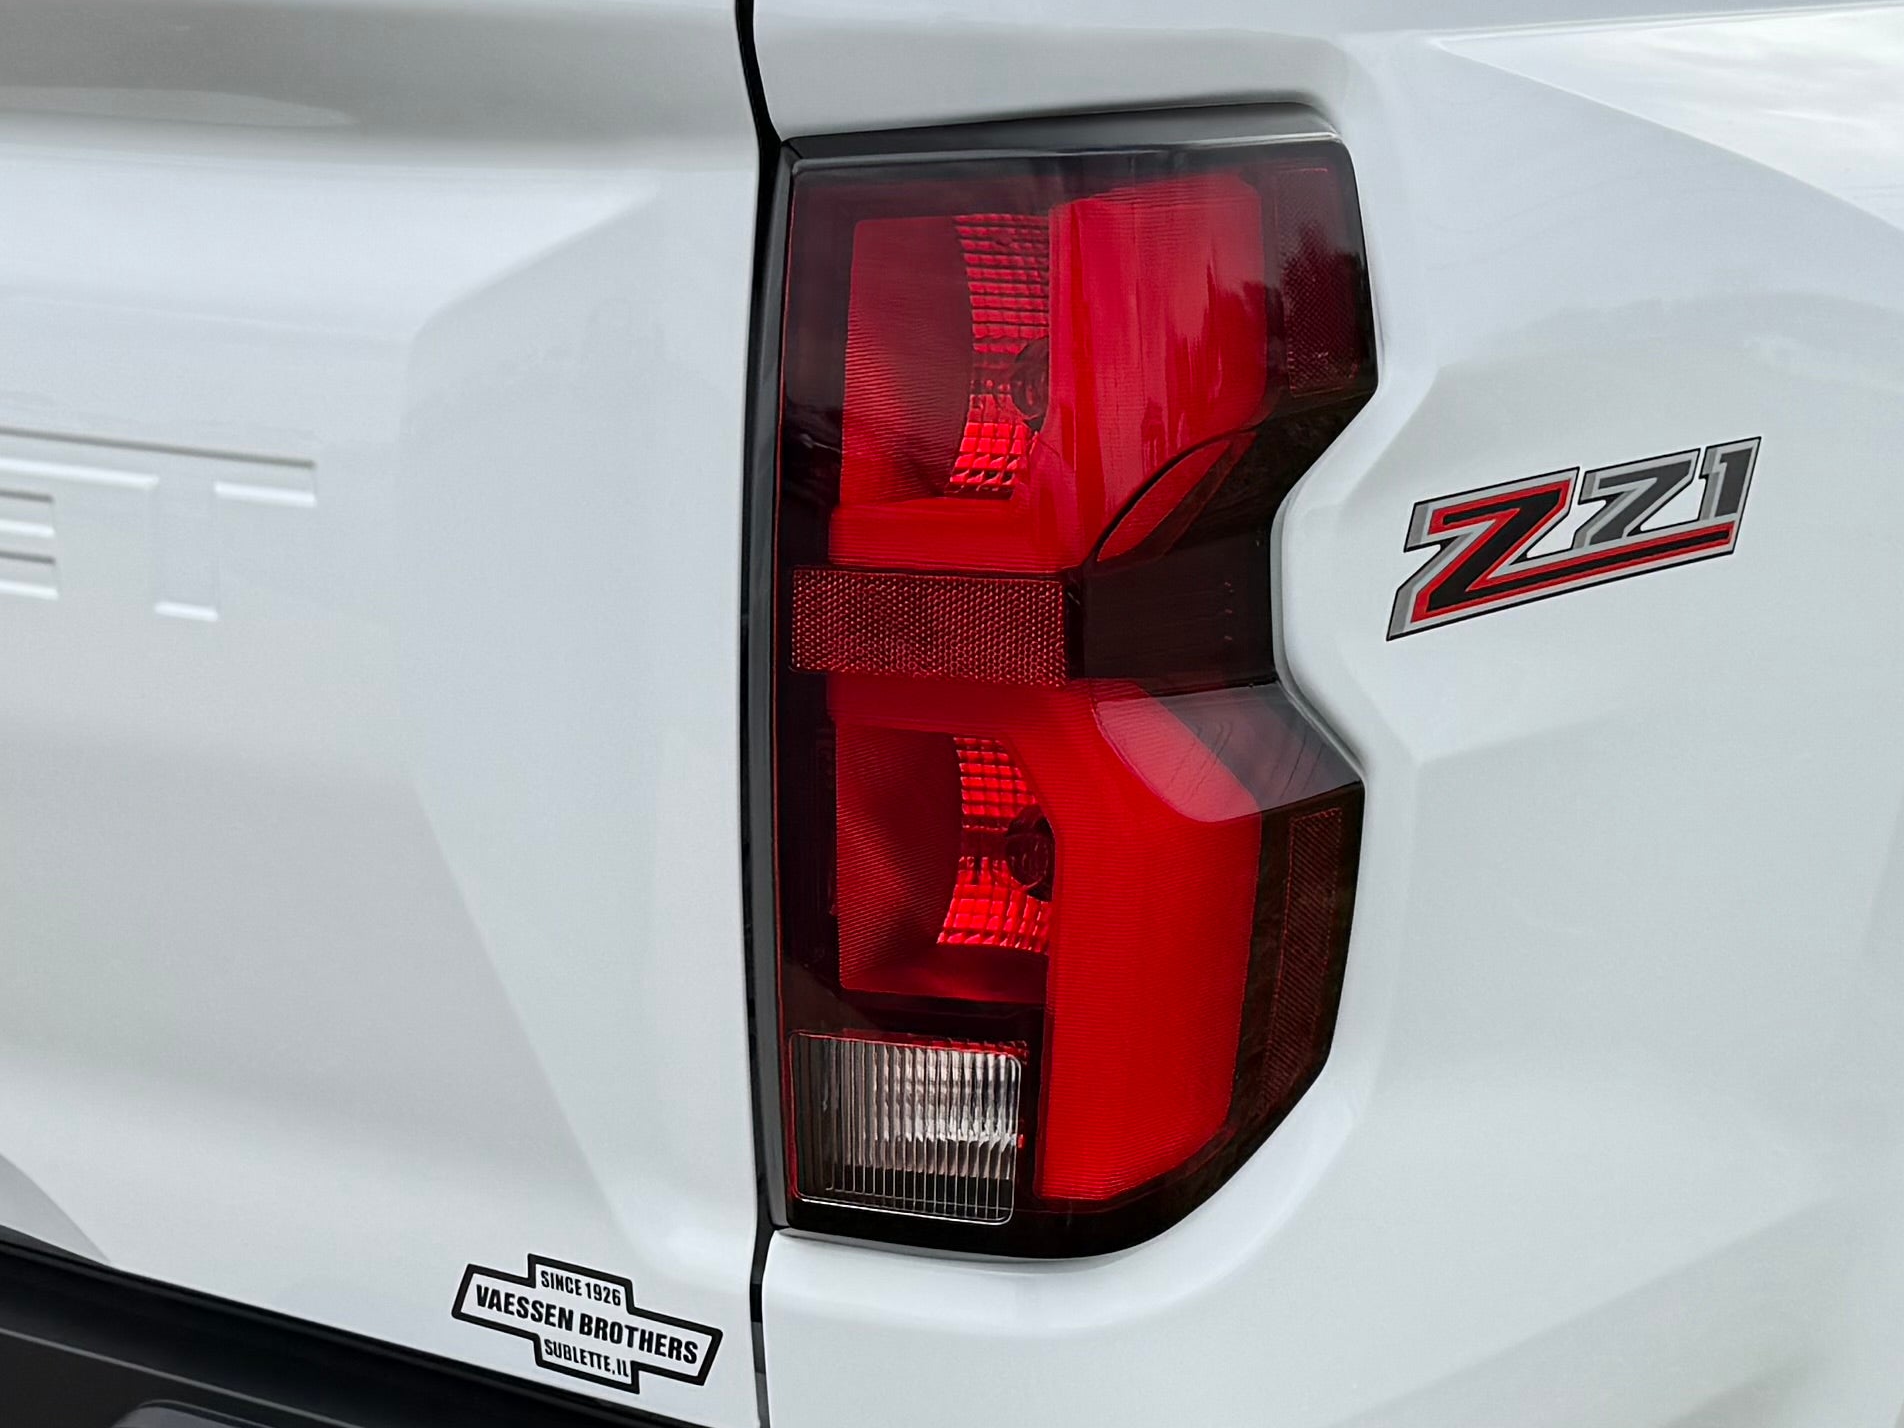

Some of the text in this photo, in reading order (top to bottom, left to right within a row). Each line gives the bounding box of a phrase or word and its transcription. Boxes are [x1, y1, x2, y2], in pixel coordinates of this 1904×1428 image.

[1386, 436, 1762, 642] Z71
[476, 1283, 699, 1365] VAESSEN BROTHERS
[540, 1270, 622, 1307] SINCE 1926
